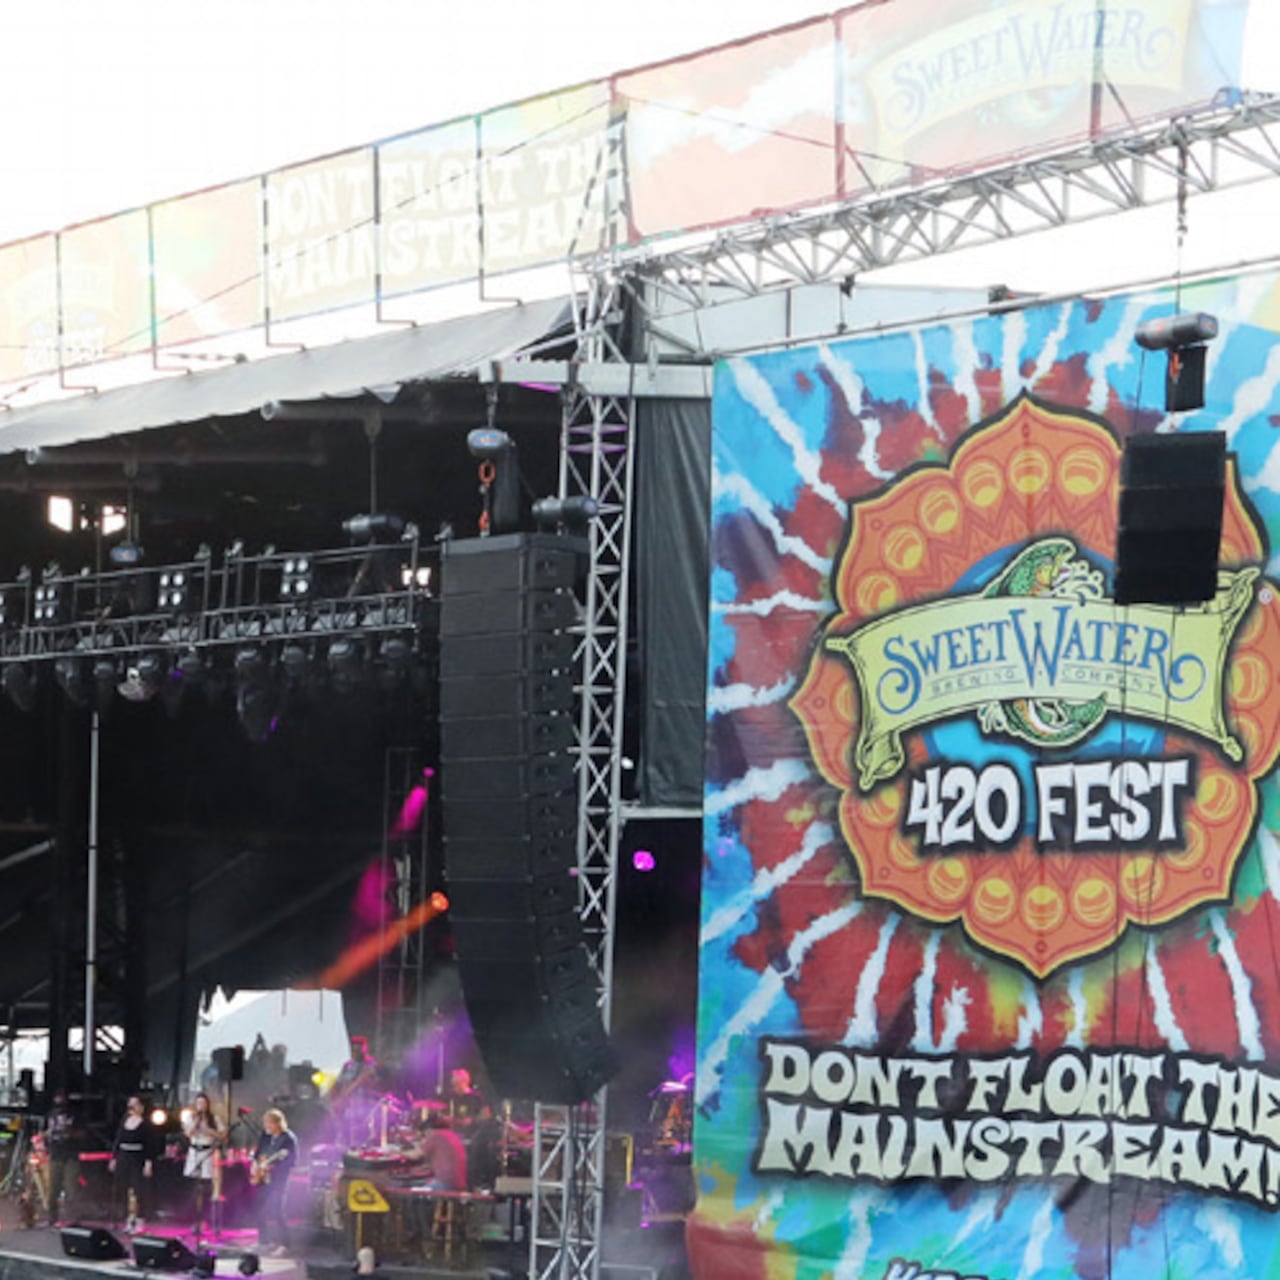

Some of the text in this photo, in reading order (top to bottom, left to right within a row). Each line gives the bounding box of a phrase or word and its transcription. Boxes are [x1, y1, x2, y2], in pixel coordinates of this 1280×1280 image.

[930, 669, 1017, 695] BREWING
[906, 759, 1190, 846] 420 FEST
[966, 1053, 1167, 1119] FLOAT
